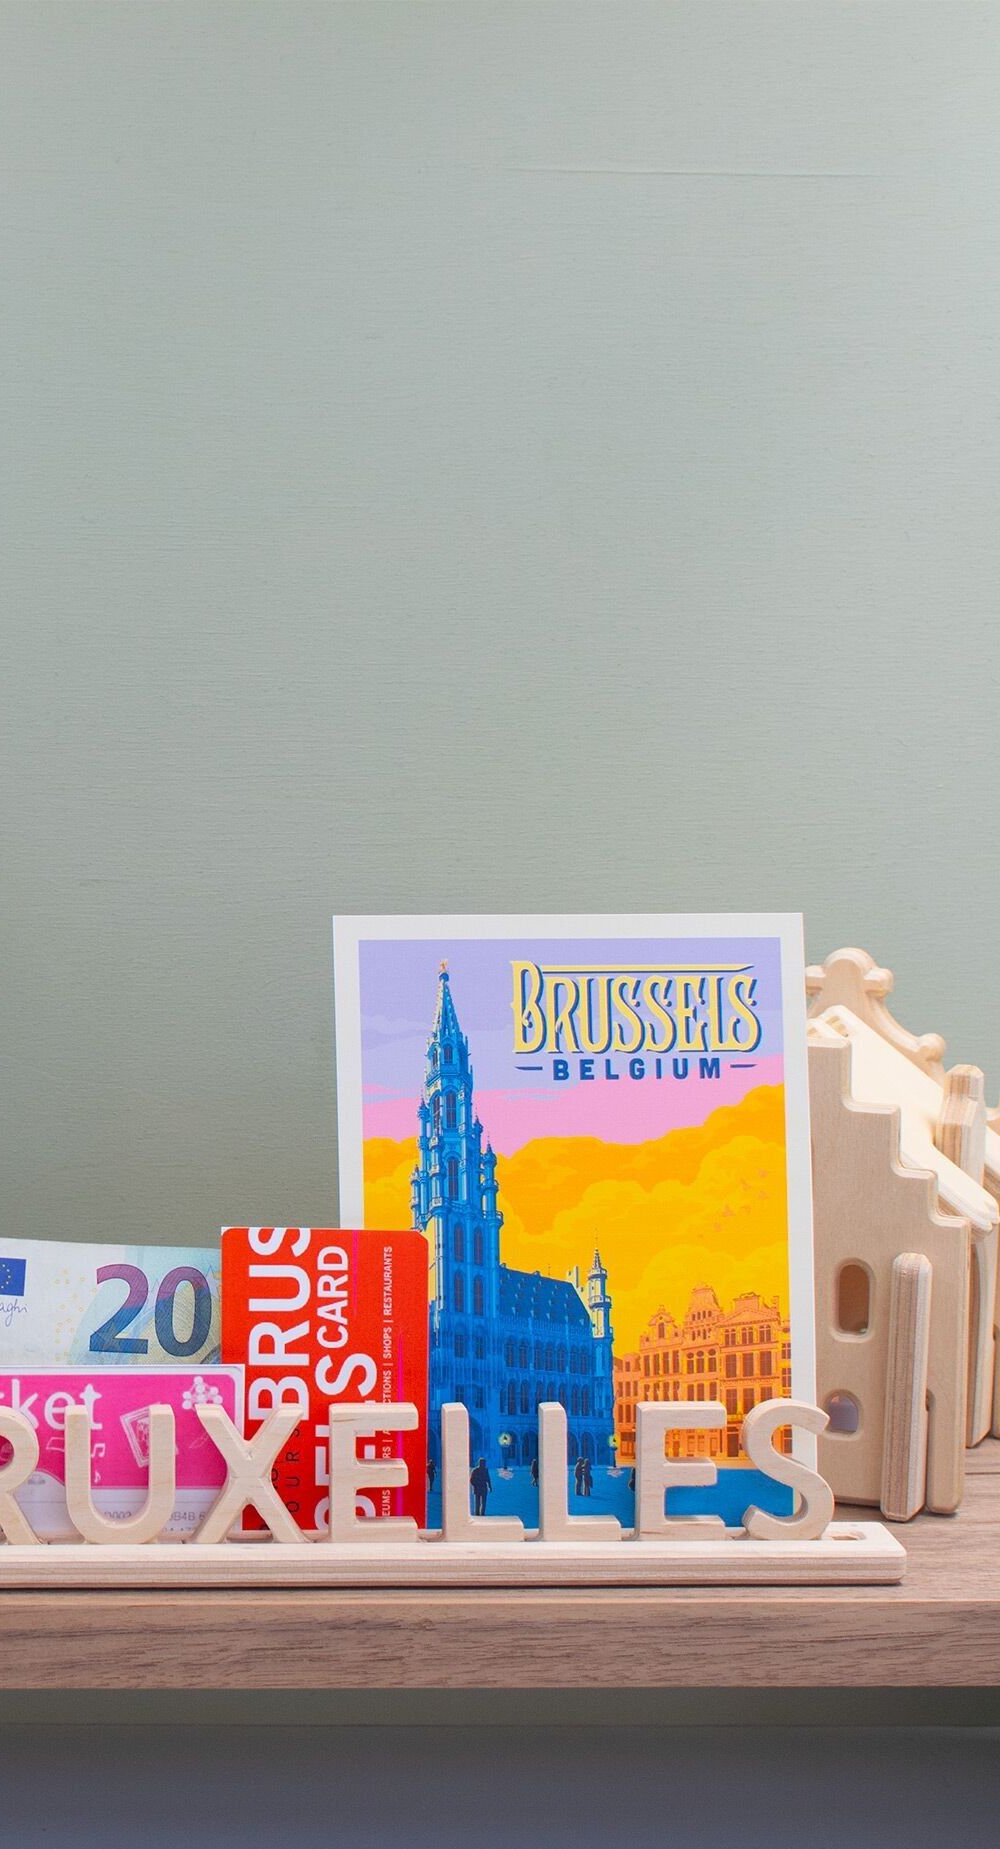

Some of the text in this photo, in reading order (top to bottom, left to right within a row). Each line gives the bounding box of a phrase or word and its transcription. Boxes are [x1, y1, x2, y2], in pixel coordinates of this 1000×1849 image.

[510, 960, 762, 1054] BRUSSELS
[553, 1058, 721, 1081] BELGIUM
[89, 1263, 213, 1358] 20
[247, 1227, 312, 1421] BRUS
[316, 1245, 349, 1349] CARD
[383, 1245, 394, 1316] RESTAURANTS
[383, 1326, 393, 1359] SHOPS
